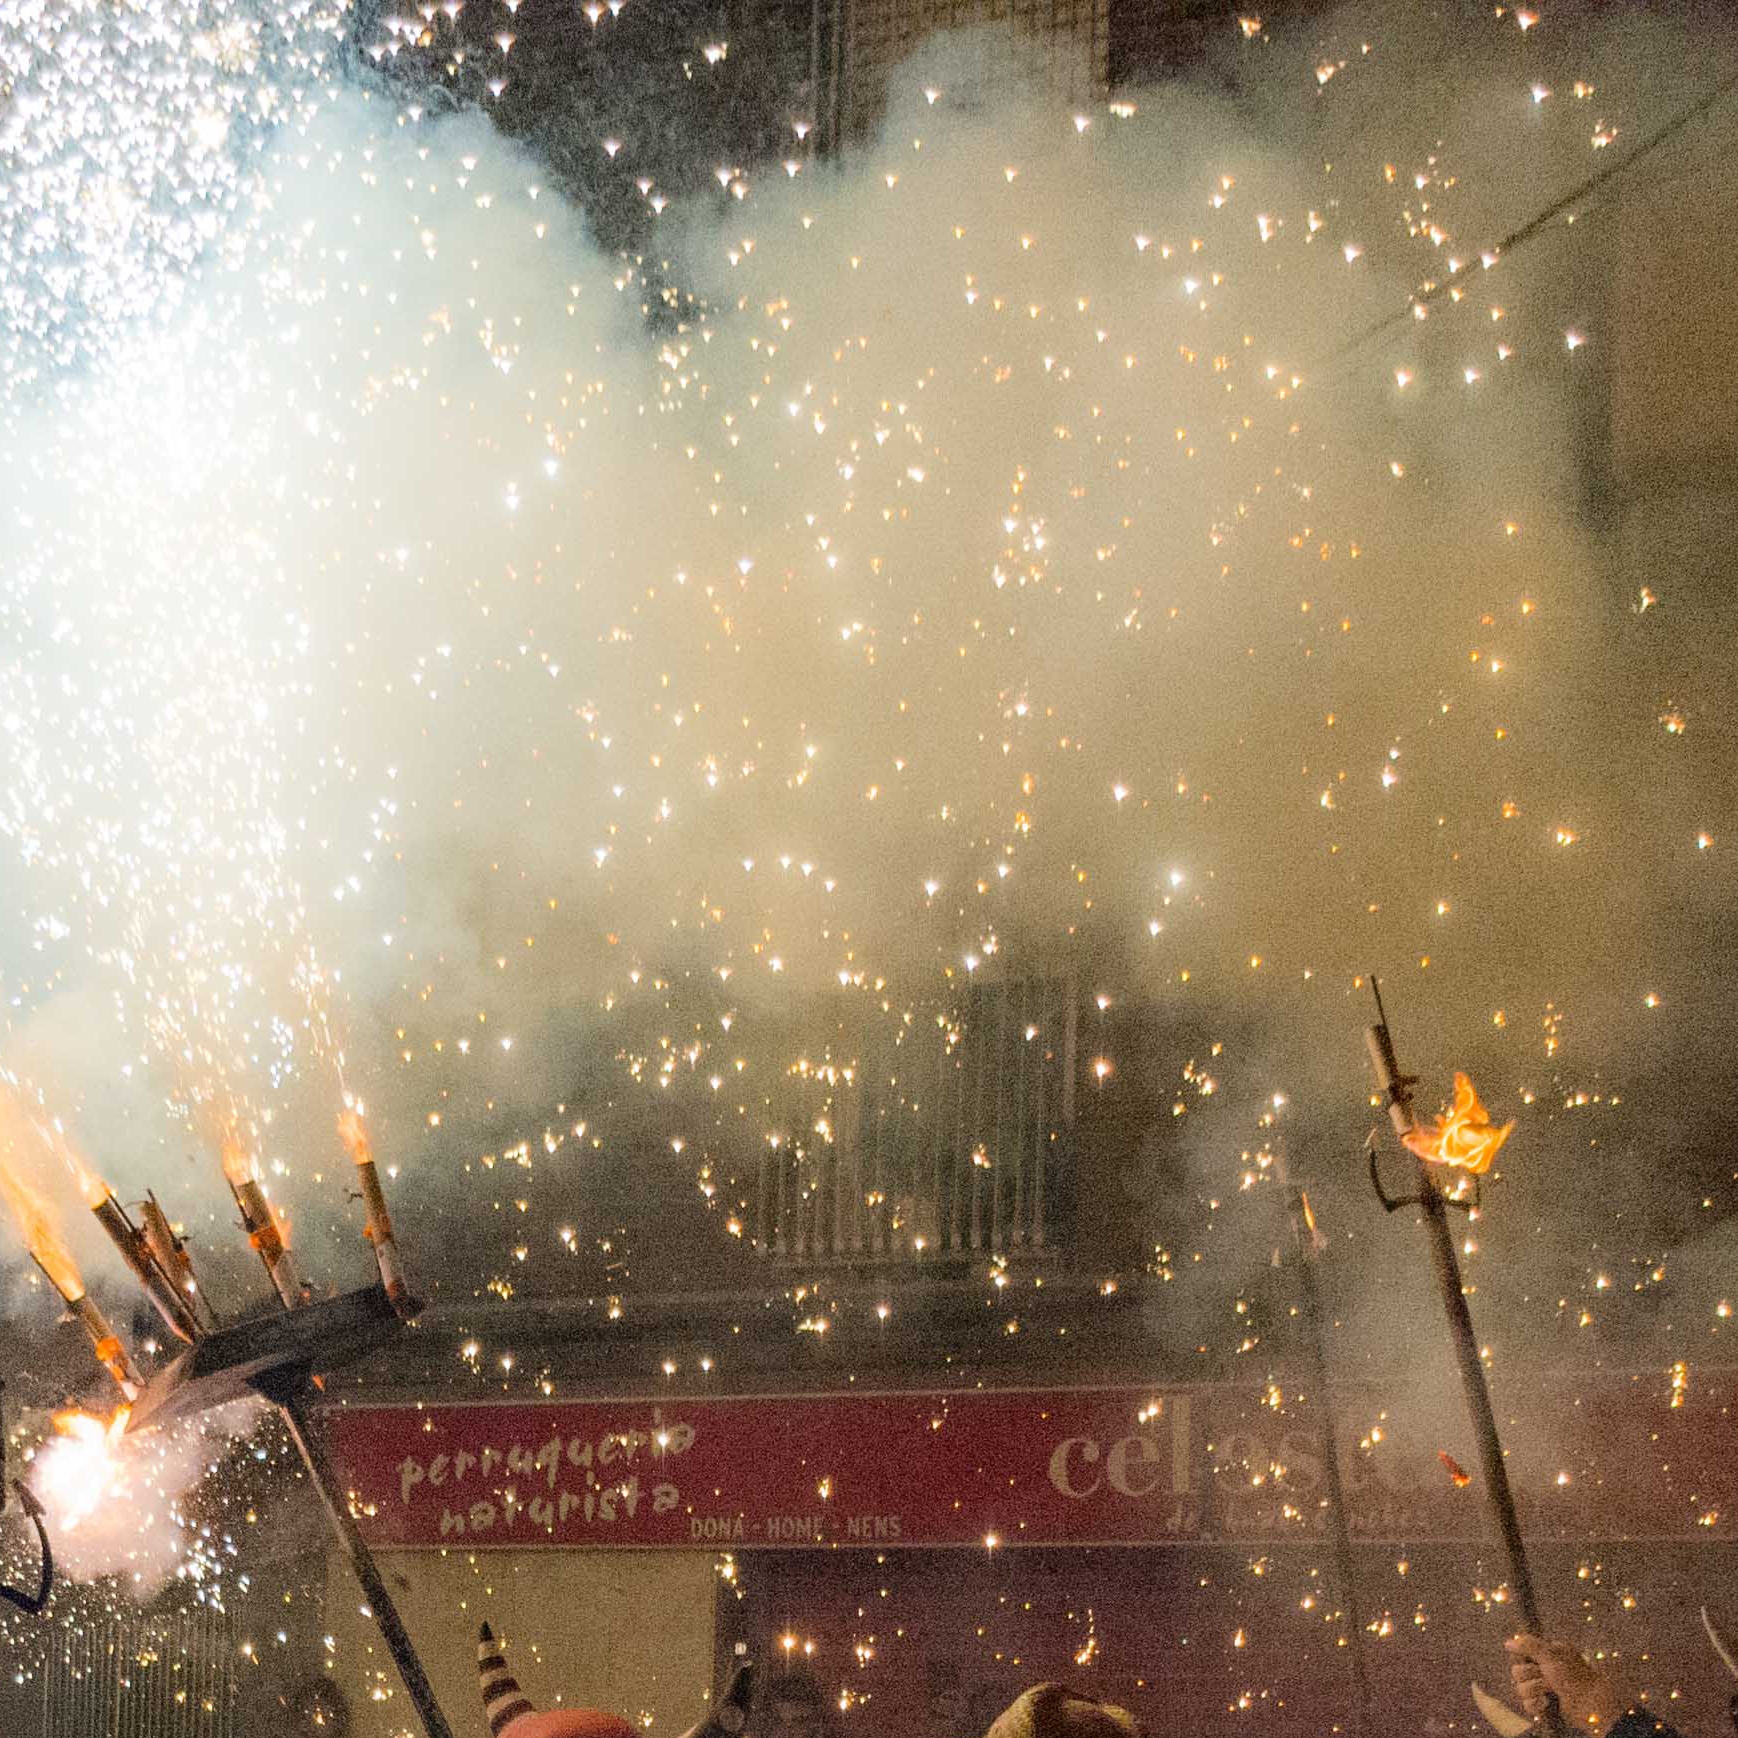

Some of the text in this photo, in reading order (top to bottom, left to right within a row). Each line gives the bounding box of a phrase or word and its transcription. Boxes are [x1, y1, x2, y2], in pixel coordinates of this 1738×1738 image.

[396, 1407, 695, 1504] perruqueria
[440, 1475, 679, 1536] naturista
[690, 1516, 744, 1538] DONA
[767, 1516, 824, 1538] HOME
[847, 1516, 902, 1538] NENS
